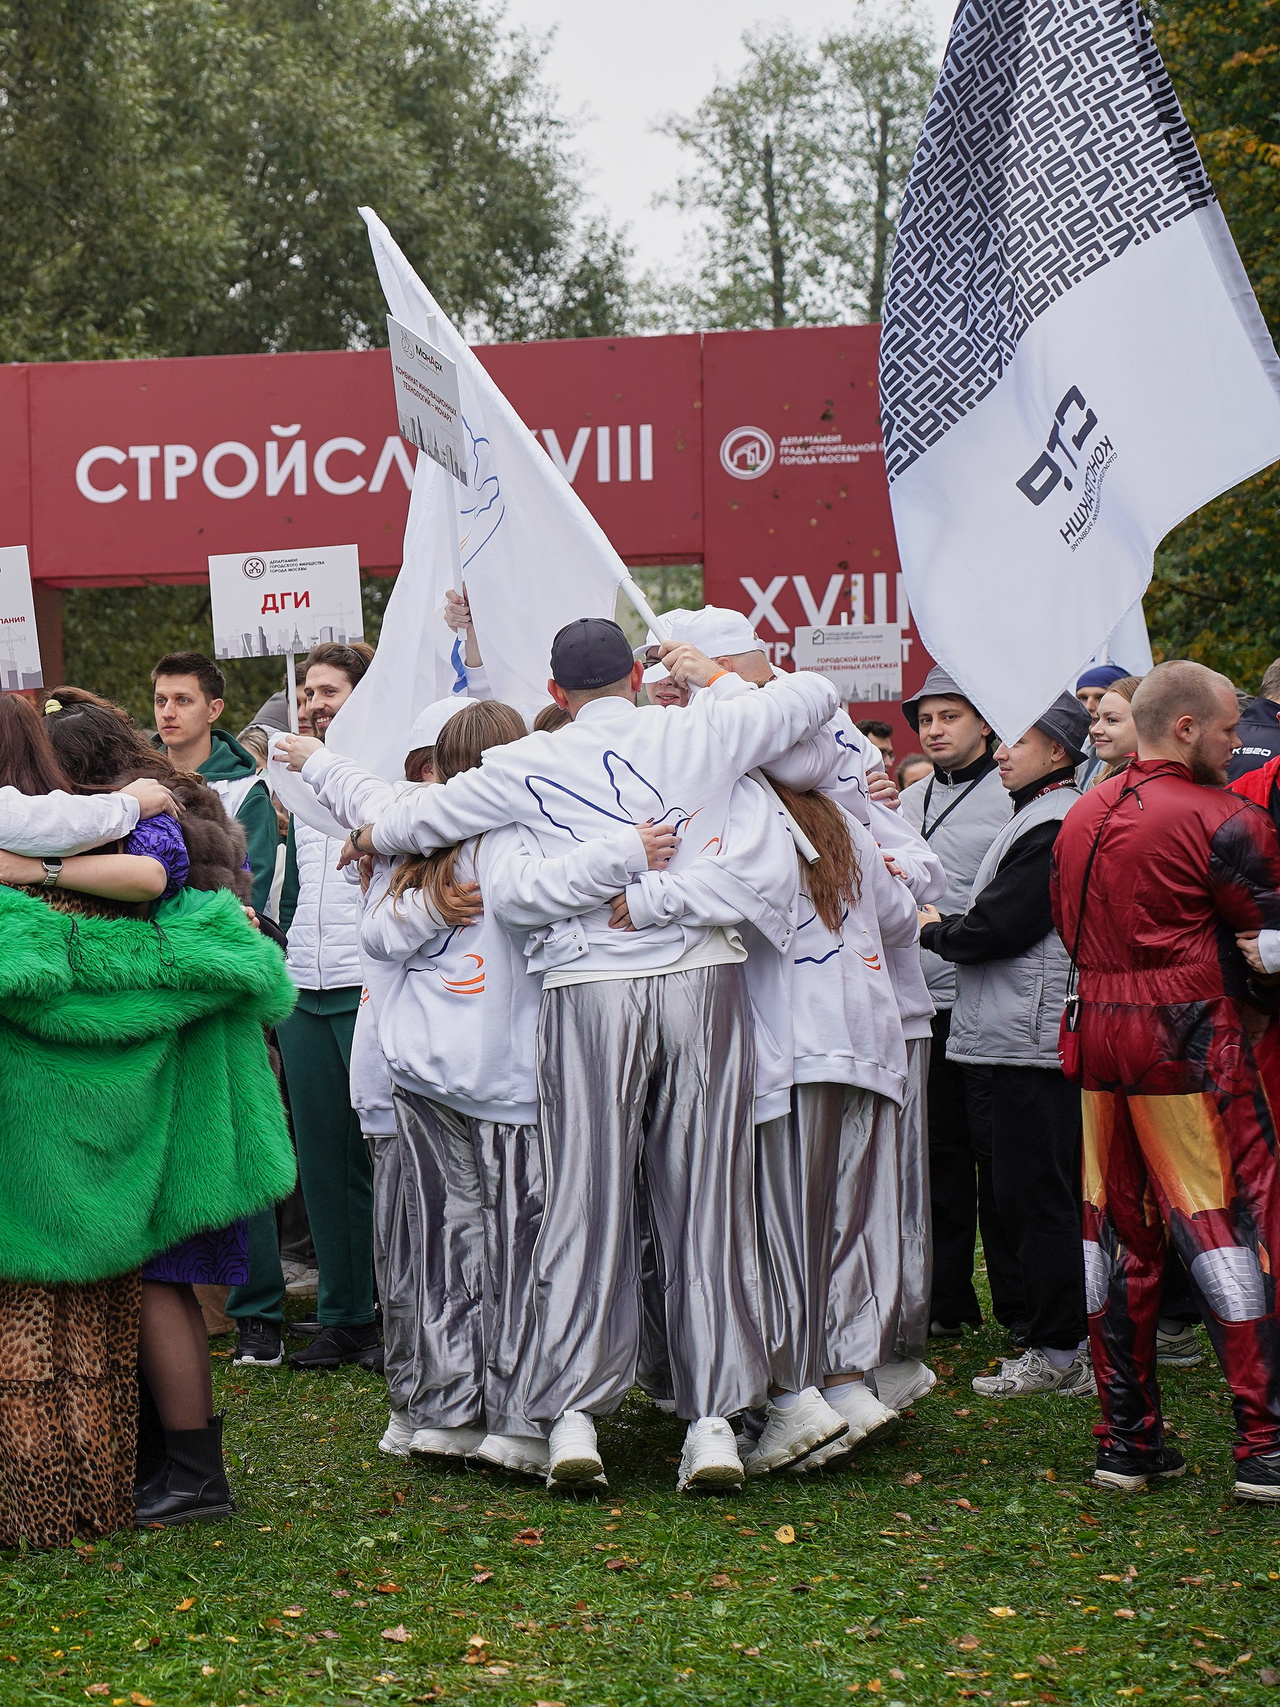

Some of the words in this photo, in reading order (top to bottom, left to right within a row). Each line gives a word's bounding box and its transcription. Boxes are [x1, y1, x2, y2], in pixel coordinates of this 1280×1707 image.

[780, 434, 842, 446] ДЕПАРТАМЕНТ
[780, 441, 878, 455] ГРАДОСТРОИТЕЛЬНОЙ
[75, 423, 413, 504] СТРОЙСЛ
[530, 424, 654, 484] VIII
[780, 455, 817, 466] ГОРОДА
[818, 453, 860, 464] МОСКВЫ
[261, 591, 310, 615] ДГИ
[739, 572, 910, 634] XVIII
[817, 655, 858, 664] ГОРОДСКОЙ
[861, 661, 898, 670] ПЛАТЕЖЕЙ
[583, 677, 604, 685] PUMA
[1241, 747, 1272, 757] 1520
